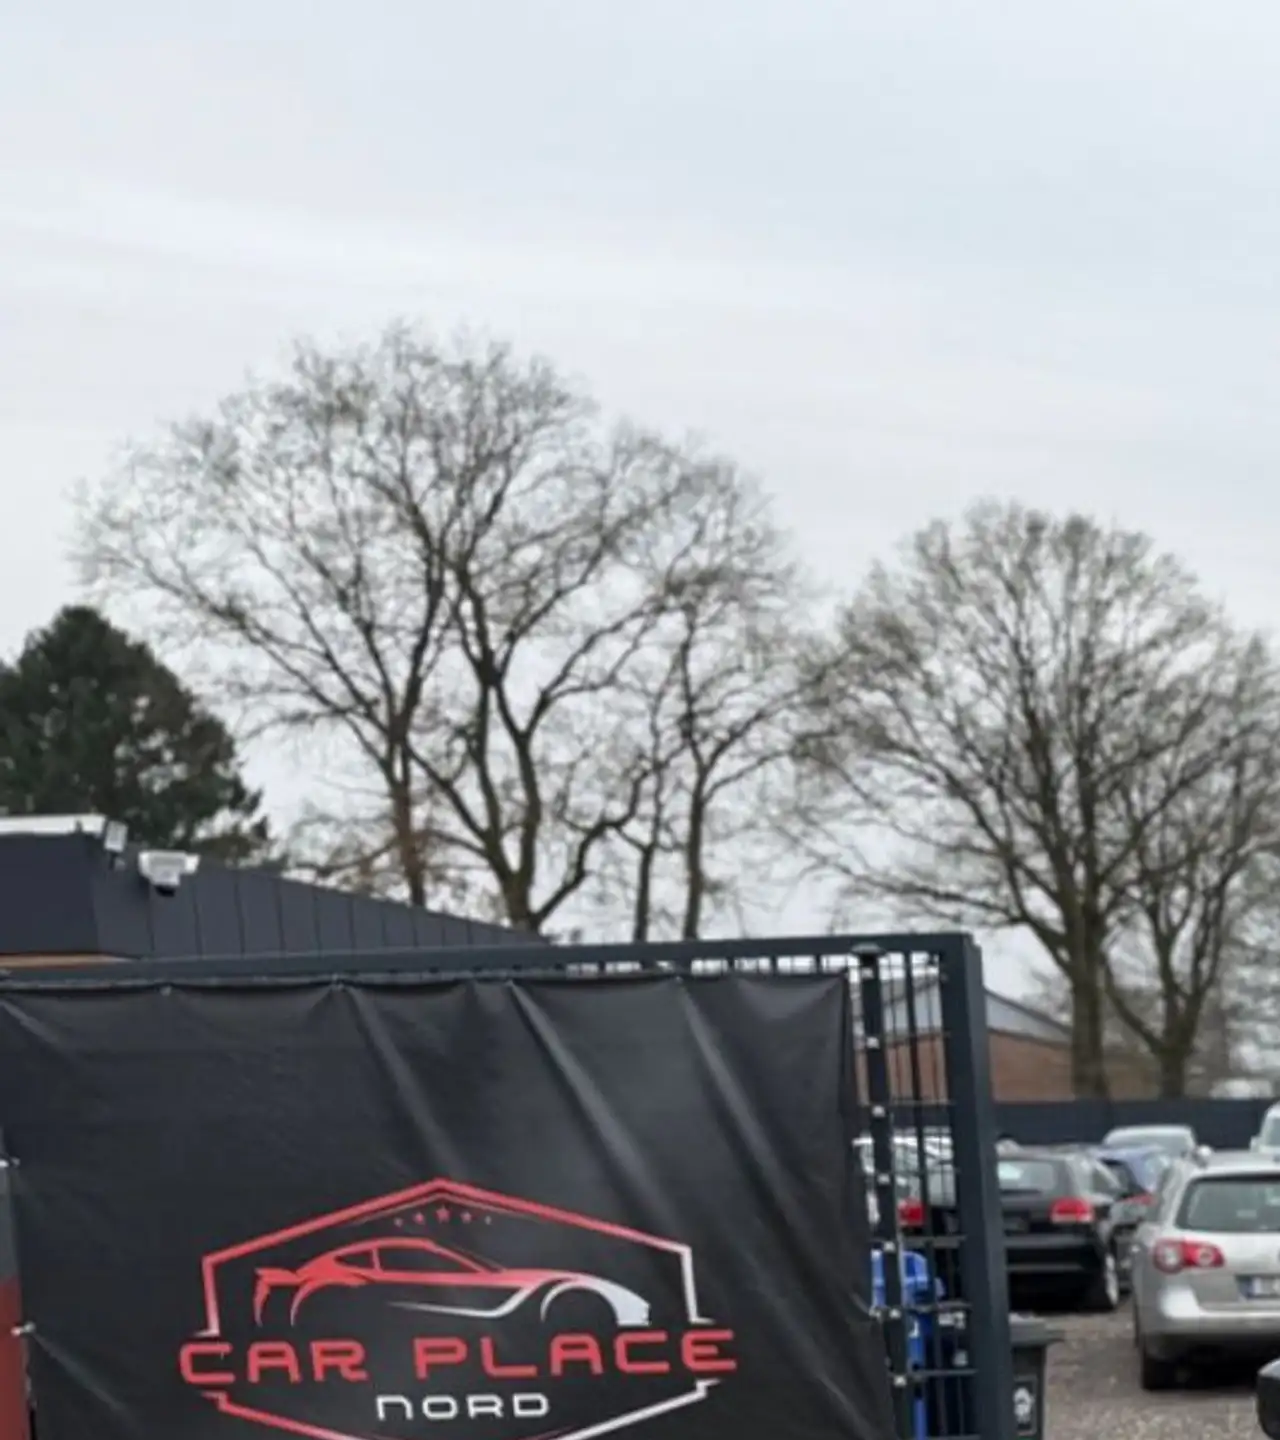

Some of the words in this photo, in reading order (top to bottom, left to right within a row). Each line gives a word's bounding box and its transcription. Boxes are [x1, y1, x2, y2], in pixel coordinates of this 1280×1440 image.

[177, 1339, 368, 1385] CAR
[413, 1329, 736, 1381] PLACE
[375, 1393, 550, 1421] NORD
